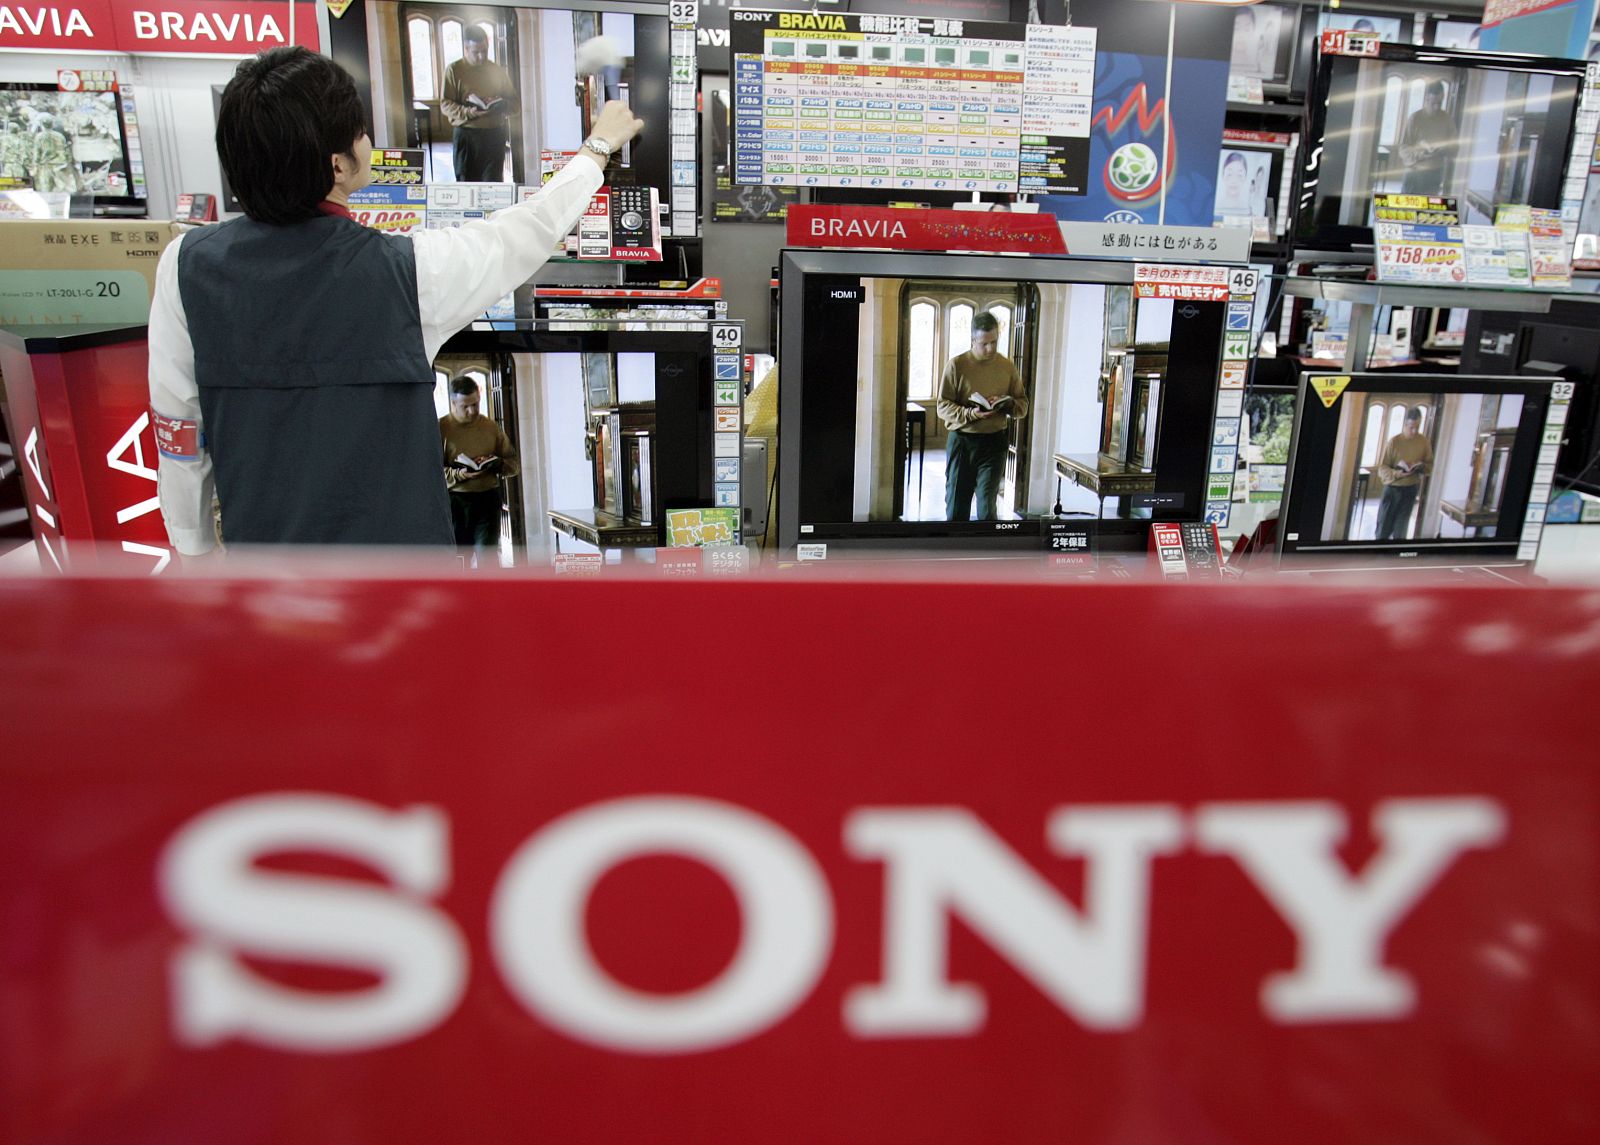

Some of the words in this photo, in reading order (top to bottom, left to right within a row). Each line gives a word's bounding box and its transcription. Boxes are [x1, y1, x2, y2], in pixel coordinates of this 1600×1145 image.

[673, 5, 694, 17] 32
[133, 11, 285, 43] BRAVIA
[734, 12, 772, 22] SONY
[779, 14, 847, 31] BRAVIA
[811, 218, 907, 239] BRAVIA
[44, 234, 66, 244] 液晶
[71, 235, 100, 245] EXE
[1102, 233, 1218, 251] 感動には色がある
[1233, 273, 1254, 288] 46
[96, 282, 120, 297] 20
[716, 329, 738, 342] 40
[1555, 385, 1572, 395] 32
[1053, 537, 1087, 548] 2年保証
[713, 552, 741, 560] らくらく
[713, 560, 741, 568] デジタル
[158, 793, 1508, 1056] SONY
